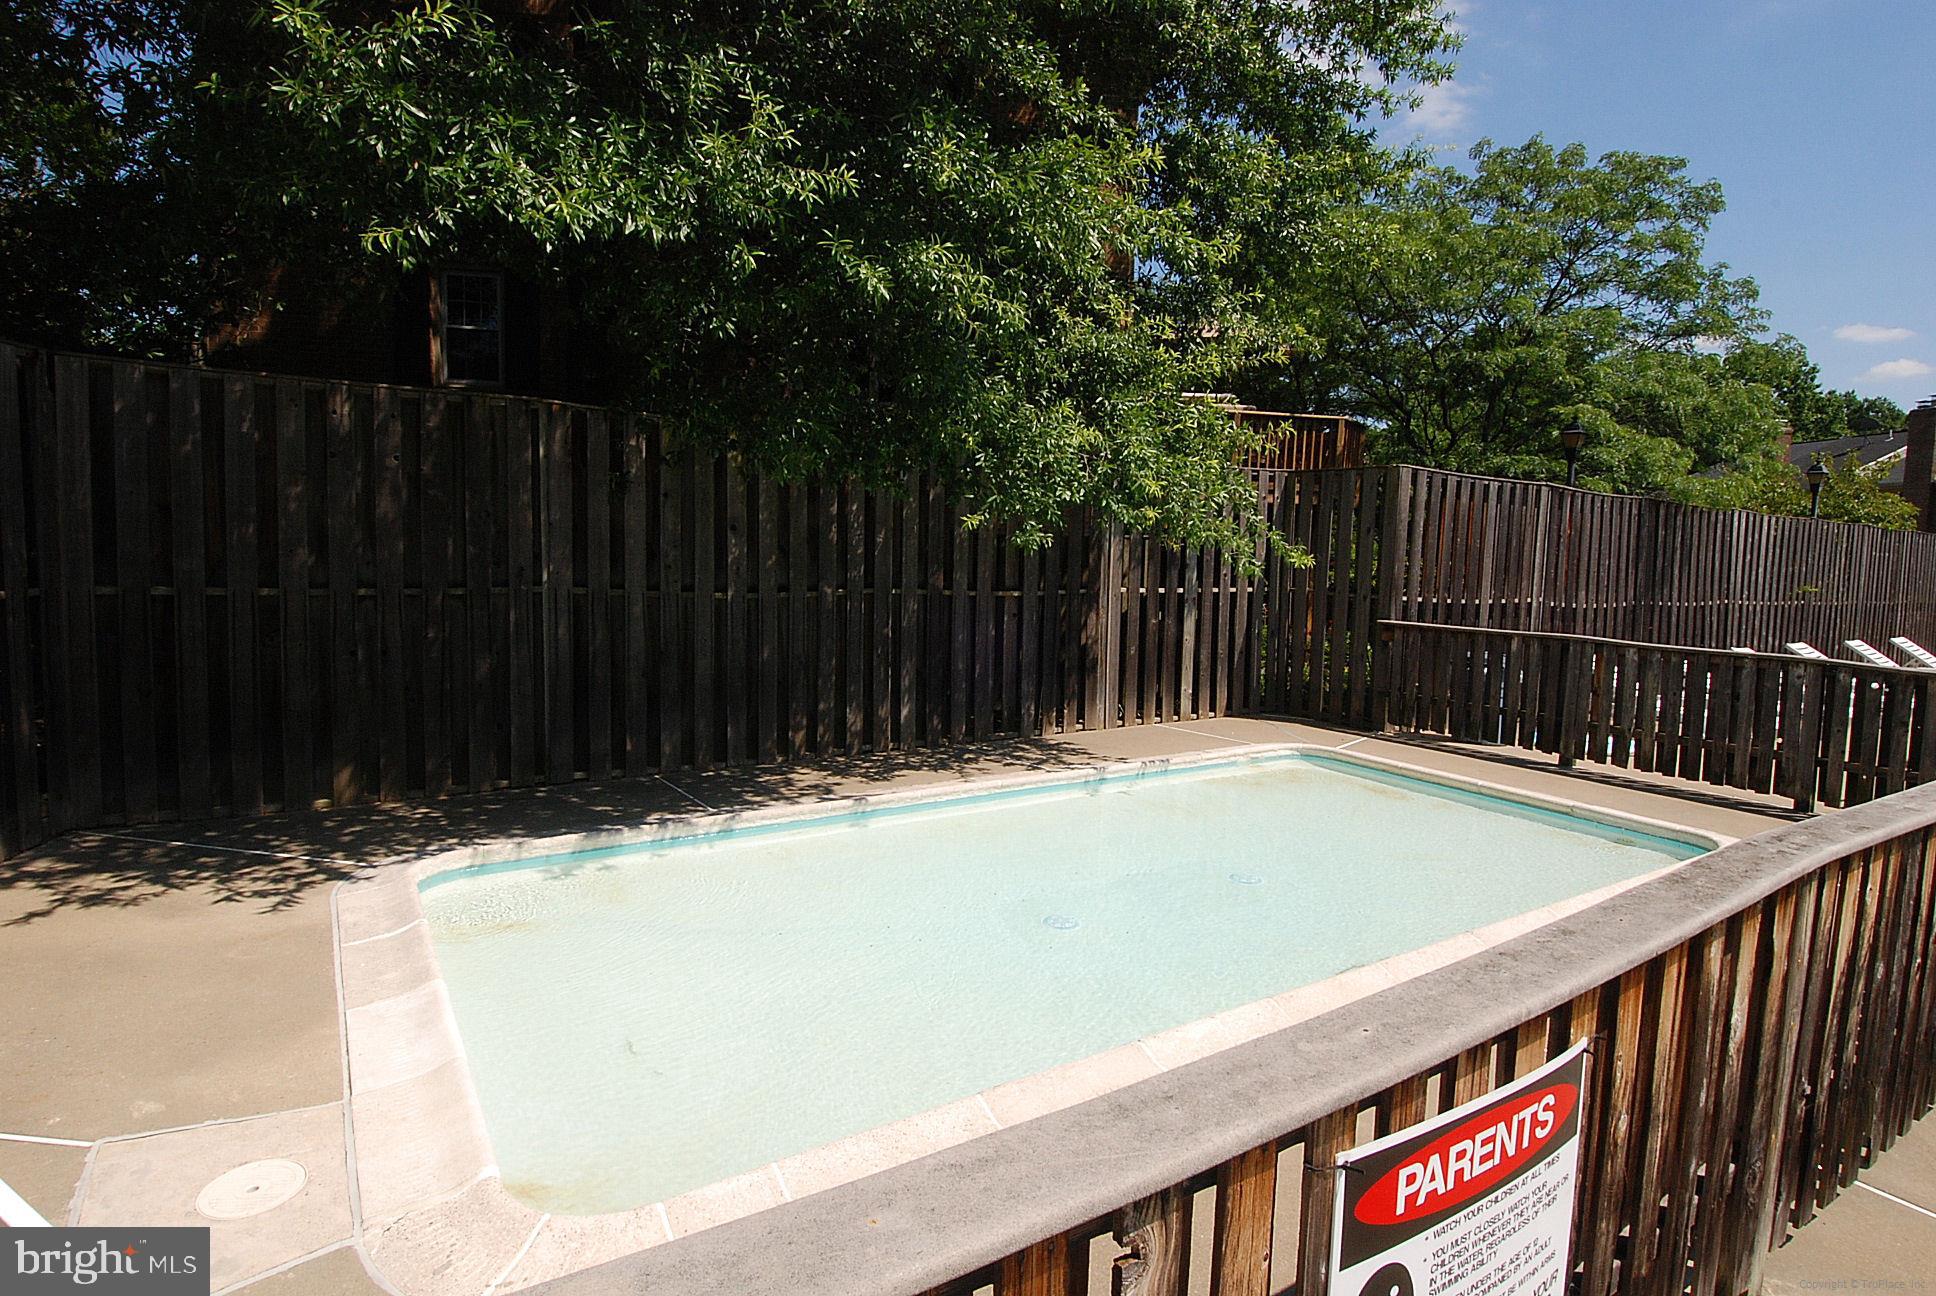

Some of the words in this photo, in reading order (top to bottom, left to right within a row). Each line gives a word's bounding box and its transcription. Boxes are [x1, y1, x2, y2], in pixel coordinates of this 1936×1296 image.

[1396, 1094, 1555, 1216] PARENTS
[1430, 1244, 1469, 1274] CHILDREN
[1472, 1217, 1511, 1249] WHENEVER
[1514, 1204, 1530, 1222] THEY
[1531, 1194, 1544, 1209] ARE
[1544, 1181, 1560, 1199] NEAR
[1561, 1173, 1569, 1185] OR
[1432, 1244, 1449, 1260] YOU
[1450, 1230, 1472, 1250] MUST
[1474, 1209, 1505, 1236] CLOSELY
[1508, 1193, 1530, 1215] WATCH
[1532, 1180, 1547, 1197] YOUR
[1433, 1216, 1461, 1239] WATCH
[1463, 1203, 1484, 1223] YOUR
[1486, 1182, 1519, 1209] CHILDREN
[1521, 1175, 1529, 1188] AT
[1530, 1167, 1541, 1181] ALL
[1544, 1153, 1560, 1171] TIMES
[1429, 1275, 1437, 1288] IN
[1440, 1264, 1455, 1280] THE
[1486, 1215, 1530, 1252] REGARDLESS
[1532, 1207, 1541, 1220] OF
[1542, 1194, 1558, 1212] THEIR
[1429, 1268, 1468, 1296] SWIMMING
[1471, 1248, 1498, 1273] ABILITY
[1467, 1273, 1491, 1295] UNDER
[1494, 1261, 1507, 1278] THE
[1508, 1250, 1522, 1267] AGE
[1523, 1242, 1532, 1255] OF
[1514, 1261, 1522, 1274] BY
[1524, 1252, 1533, 1266] AN
[1534, 1236, 1552, 1259] ADULT
[1518, 1265, 1539, 1287] WITHIN
